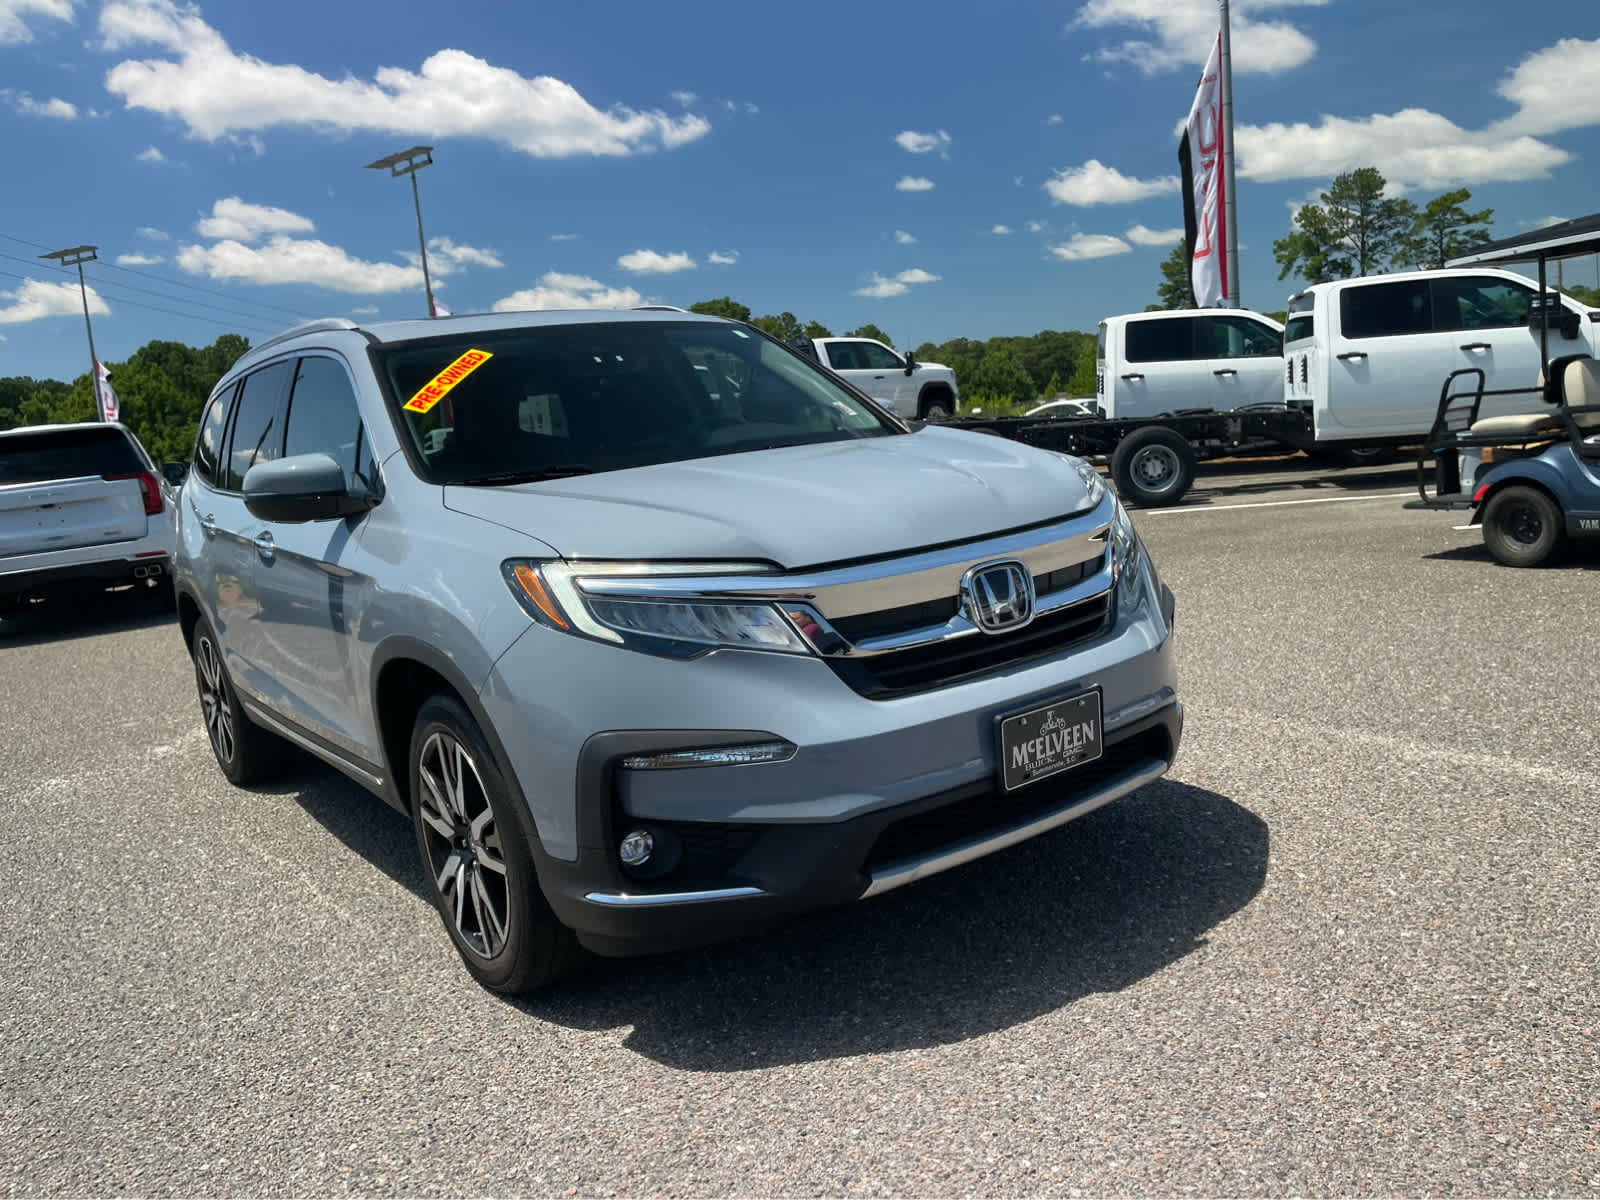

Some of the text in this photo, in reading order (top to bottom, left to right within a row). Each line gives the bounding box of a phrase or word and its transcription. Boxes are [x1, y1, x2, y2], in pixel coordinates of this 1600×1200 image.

[409, 352, 485, 411] PRE-OWNED
[1011, 720, 1095, 769] McELVEEN
[1063, 745, 1084, 758] GMC
